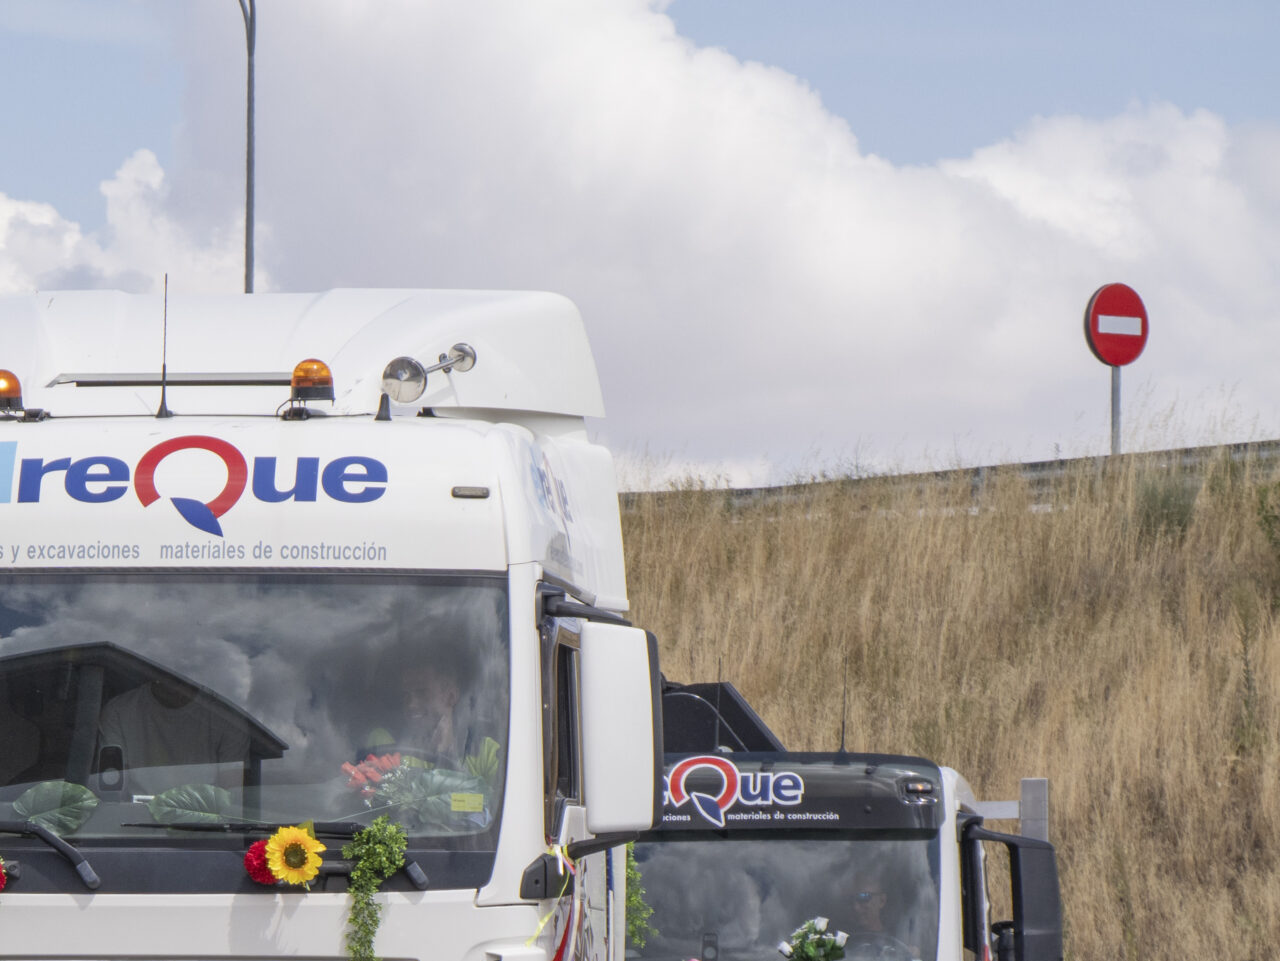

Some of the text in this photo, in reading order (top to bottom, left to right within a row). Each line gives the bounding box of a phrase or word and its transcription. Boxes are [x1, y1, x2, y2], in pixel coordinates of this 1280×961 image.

[11, 544, 20, 564] y
[27, 540, 140, 560] excavaciones
[160, 540, 387, 561] materiales de construcción
[727, 811, 840, 821] materiales de construcción
